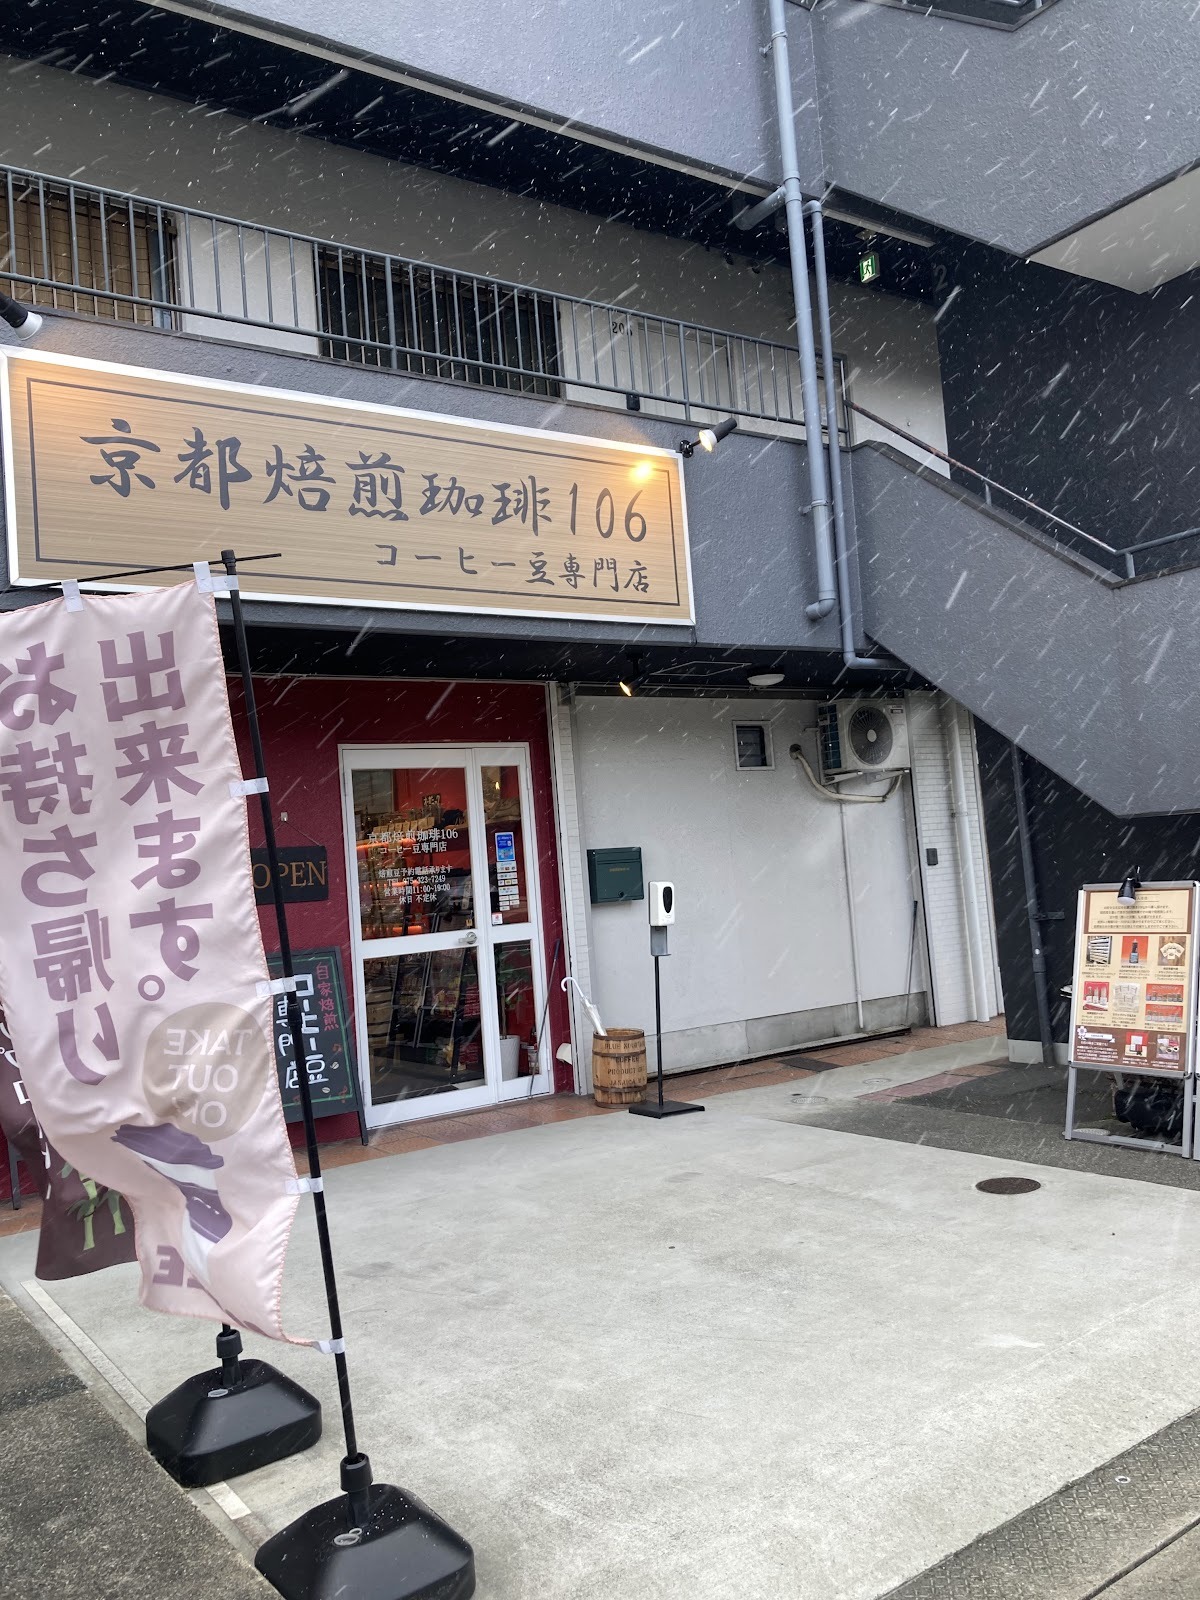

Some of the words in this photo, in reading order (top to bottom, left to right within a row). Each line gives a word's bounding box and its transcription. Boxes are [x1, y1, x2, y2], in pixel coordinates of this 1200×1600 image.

[79, 418, 647, 543] 京都焙煎珈琲106
[375, 543, 650, 595] コーヒー豆専門店
[379, 841, 448, 855] コーヒー豆専門店
[252, 861, 327, 889] OPEN
[316, 962, 340, 1031] 自家焙煎
